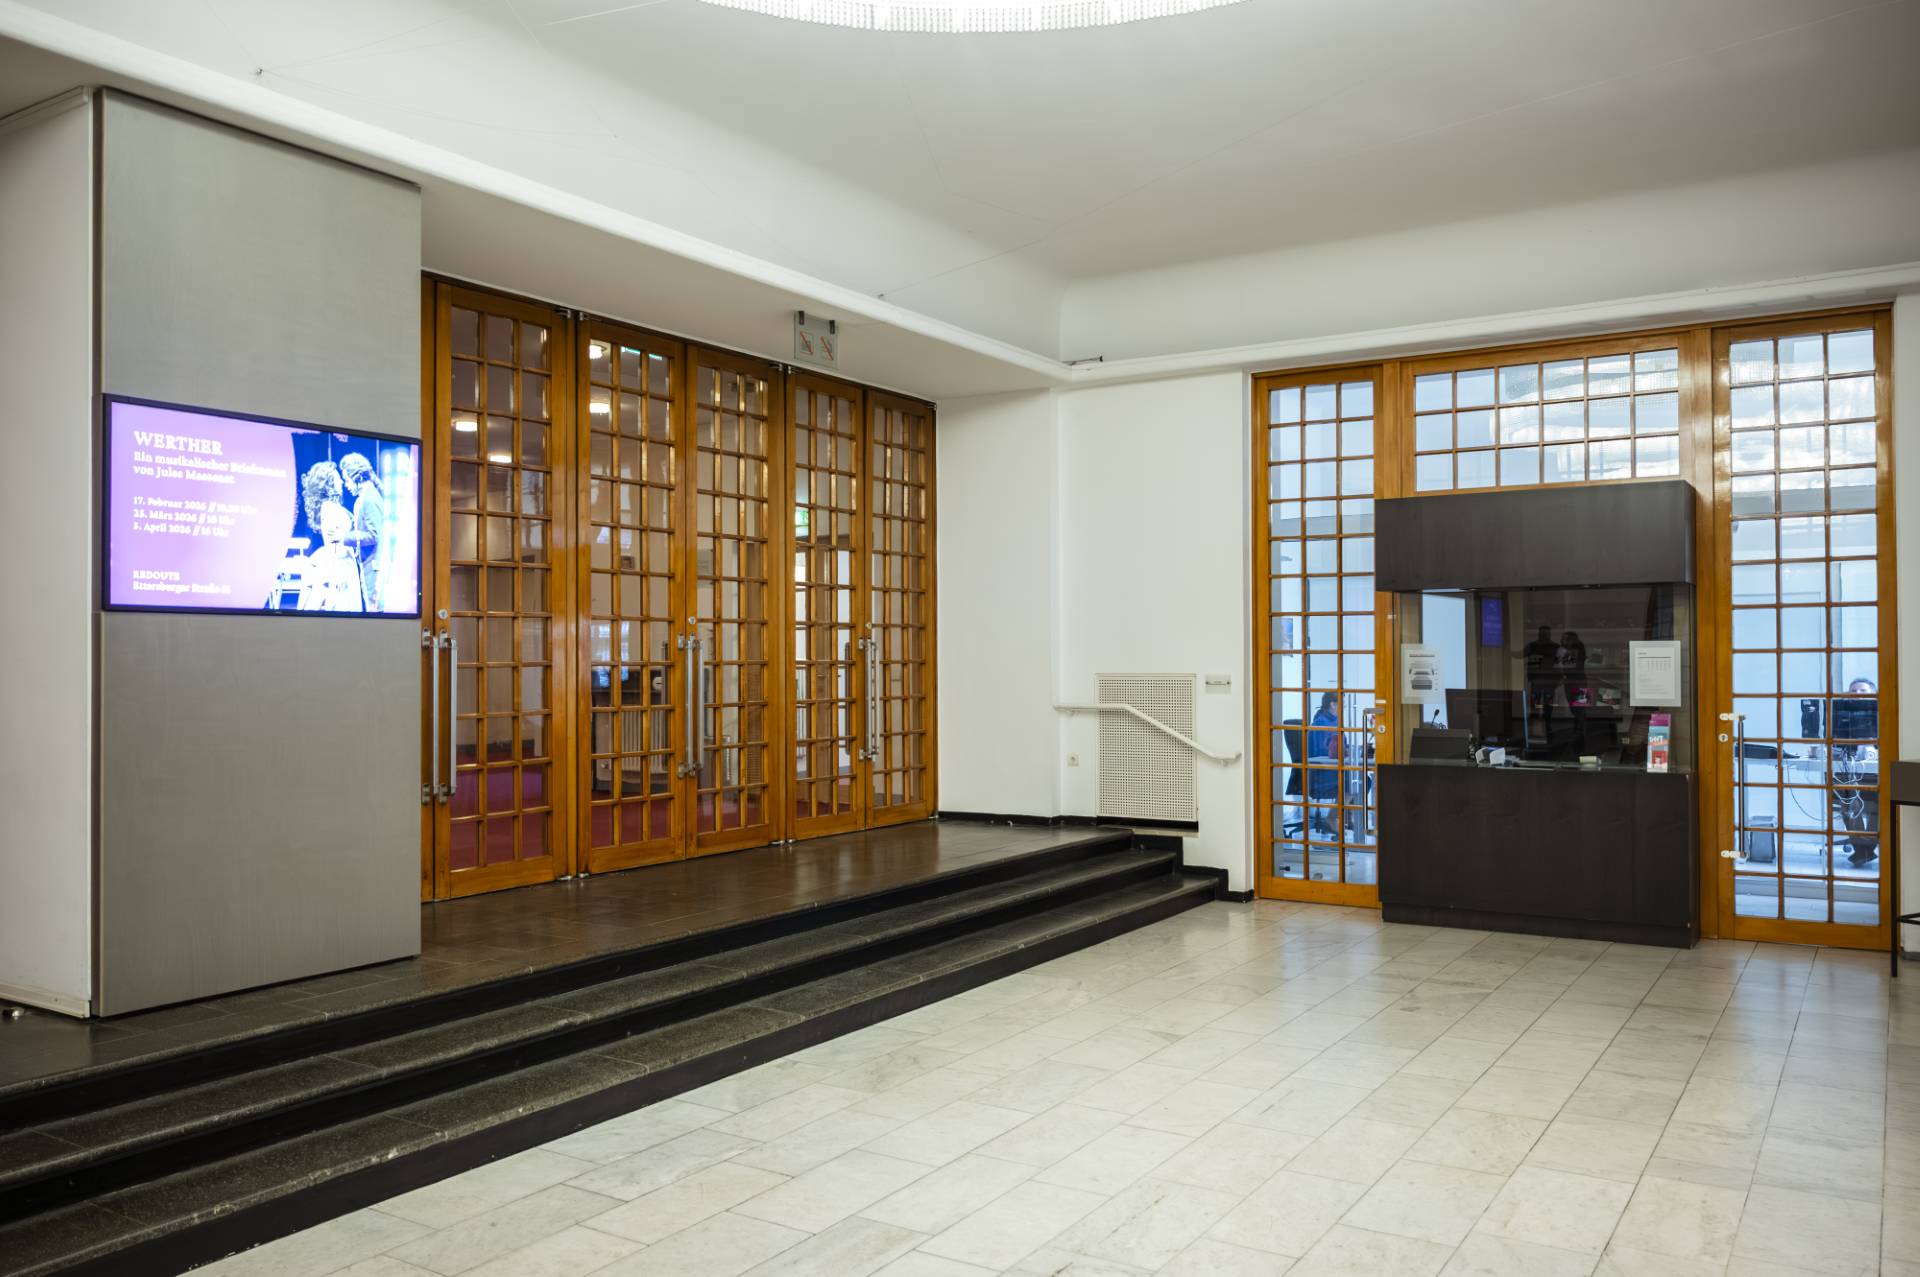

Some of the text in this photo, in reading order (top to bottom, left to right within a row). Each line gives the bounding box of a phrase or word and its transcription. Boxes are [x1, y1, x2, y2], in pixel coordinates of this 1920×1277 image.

[134, 431, 223, 456] WERTHER
[134, 452, 153, 463] Ein
[133, 466, 154, 476] von
[155, 467, 183, 479] Jules
[147, 497, 183, 509] Februar
[149, 510, 173, 521] März
[144, 522, 167, 535] April
